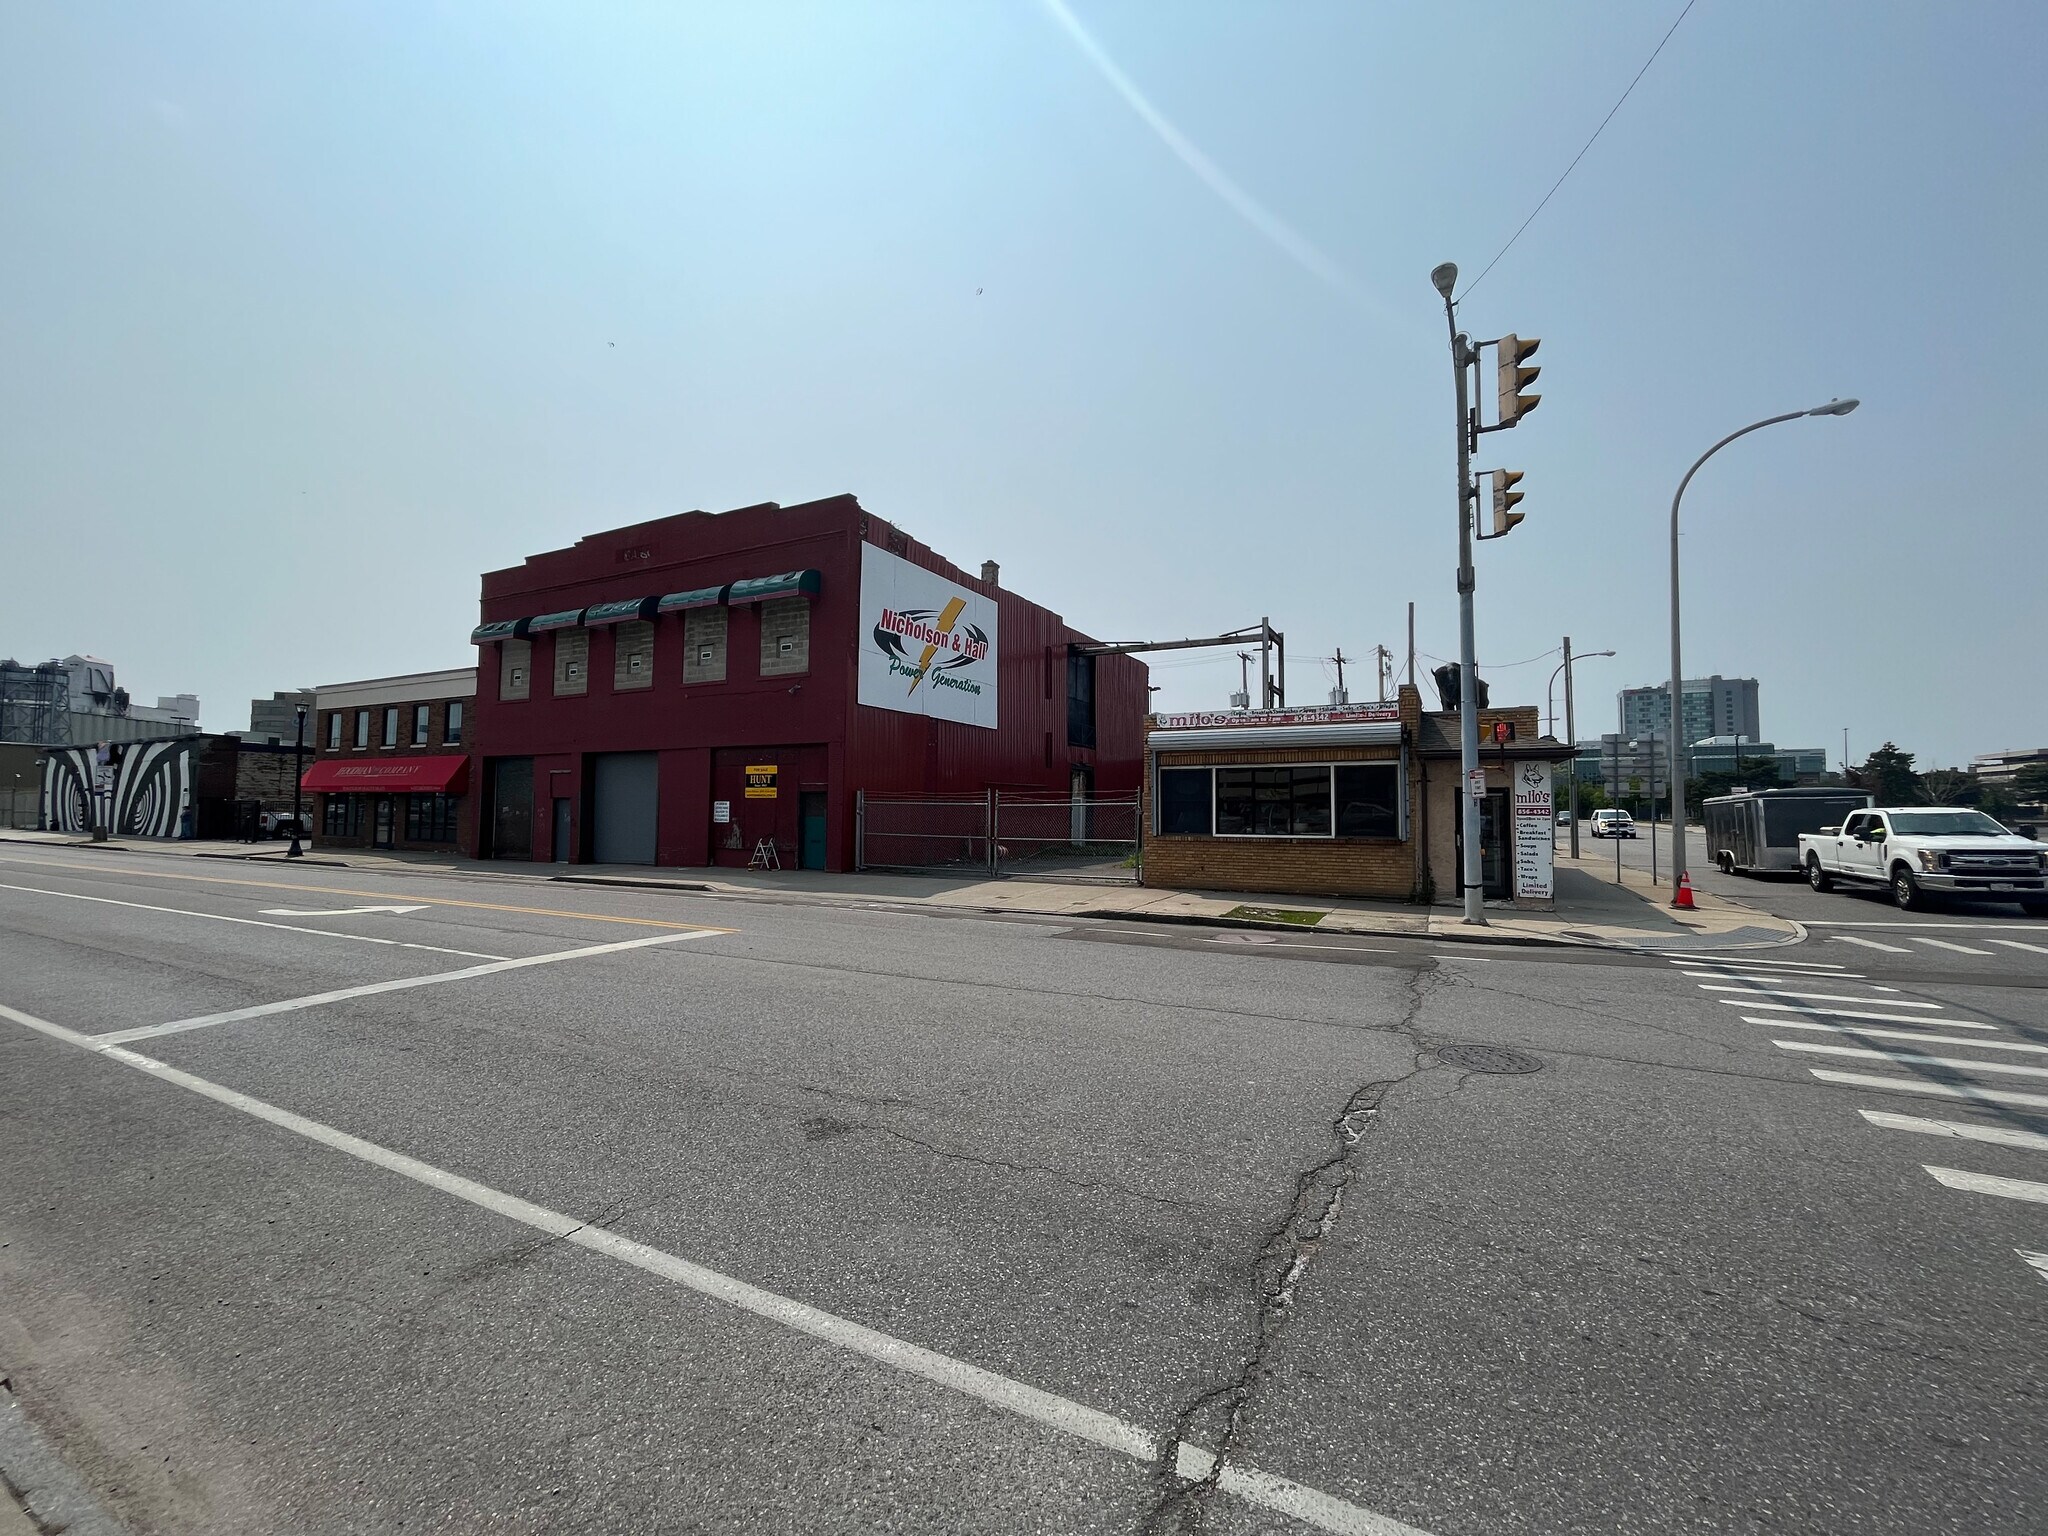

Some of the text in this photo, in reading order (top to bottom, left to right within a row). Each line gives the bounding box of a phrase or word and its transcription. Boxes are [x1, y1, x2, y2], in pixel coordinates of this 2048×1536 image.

[881, 608, 987, 660] Nicholson & Hall
[888, 655, 981, 696] Power Generation
[1169, 713, 1227, 727] milo's
[750, 775, 772, 784] HUNT
[1515, 790, 1550, 803] milo's
[1521, 888, 1549, 897] Delivery
